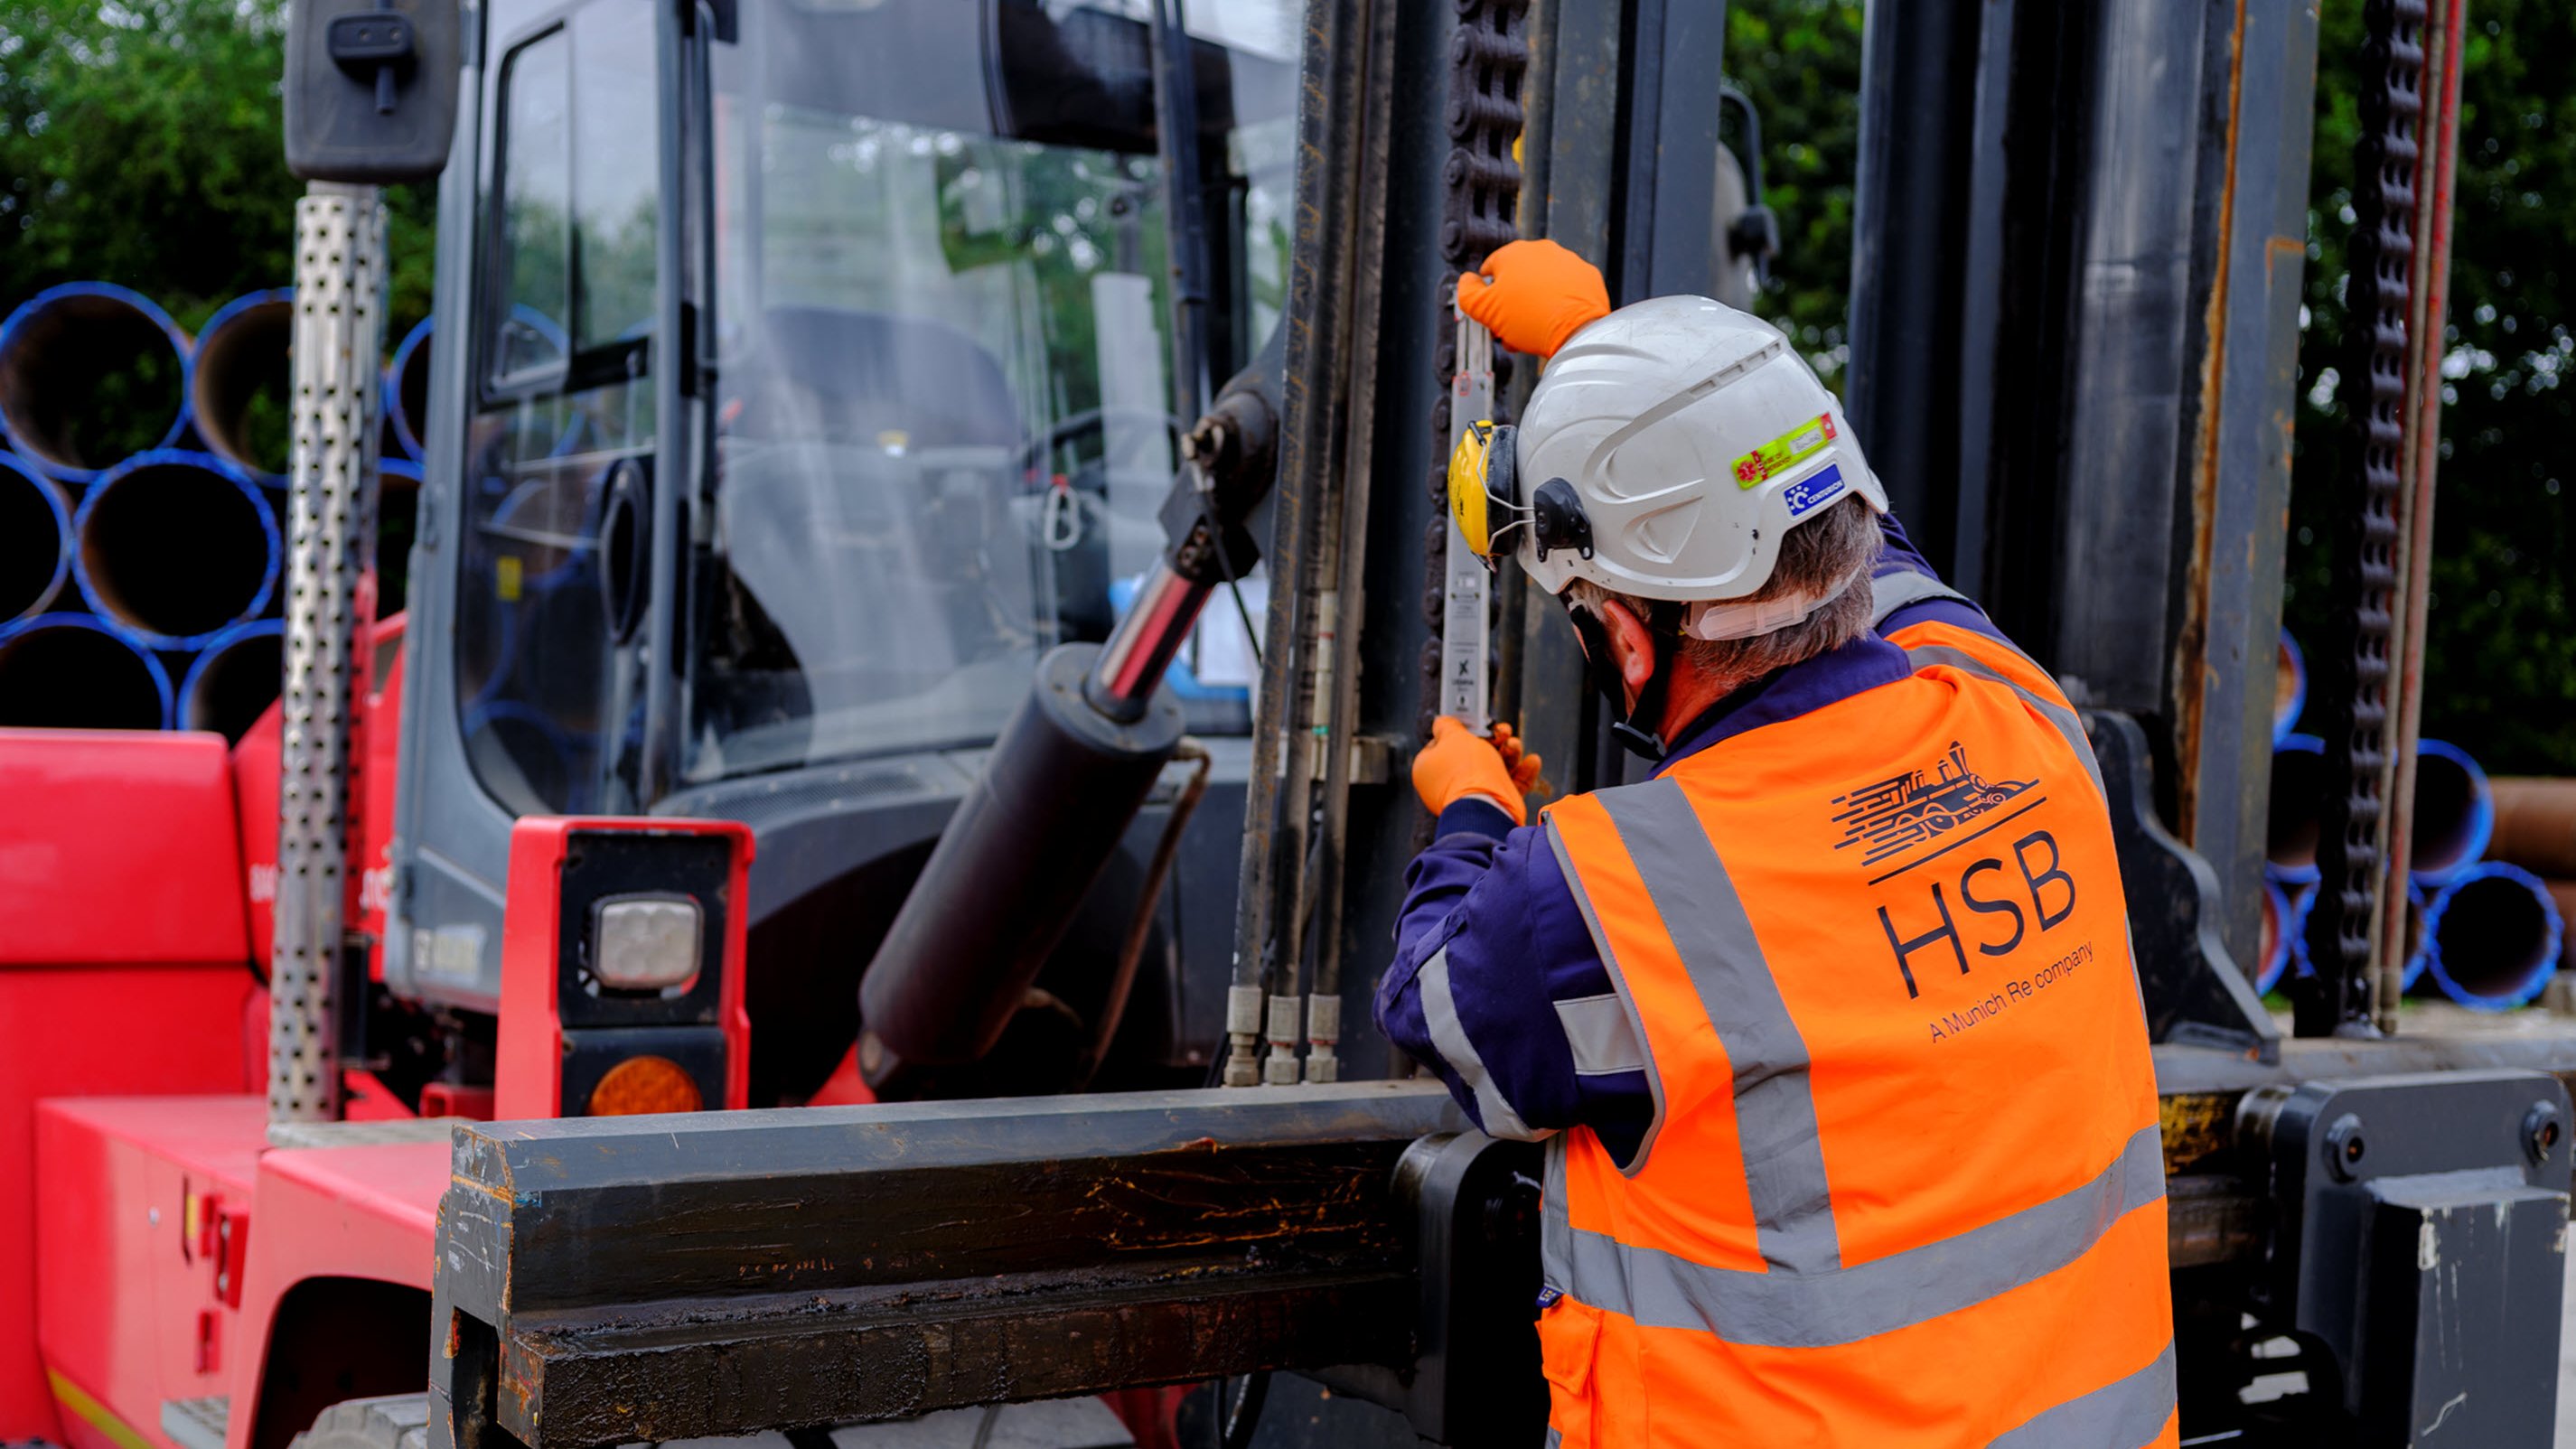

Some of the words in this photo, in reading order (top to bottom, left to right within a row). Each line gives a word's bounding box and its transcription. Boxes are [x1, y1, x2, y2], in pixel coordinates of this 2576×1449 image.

[1807, 480, 1842, 504] CENTURION
[1877, 829, 2076, 1000] HSB
[1929, 1023, 1947, 1044] A
[1943, 993, 2008, 1035] Munich
[2006, 980, 2033, 1003] Re
[2035, 940, 2094, 989] company
